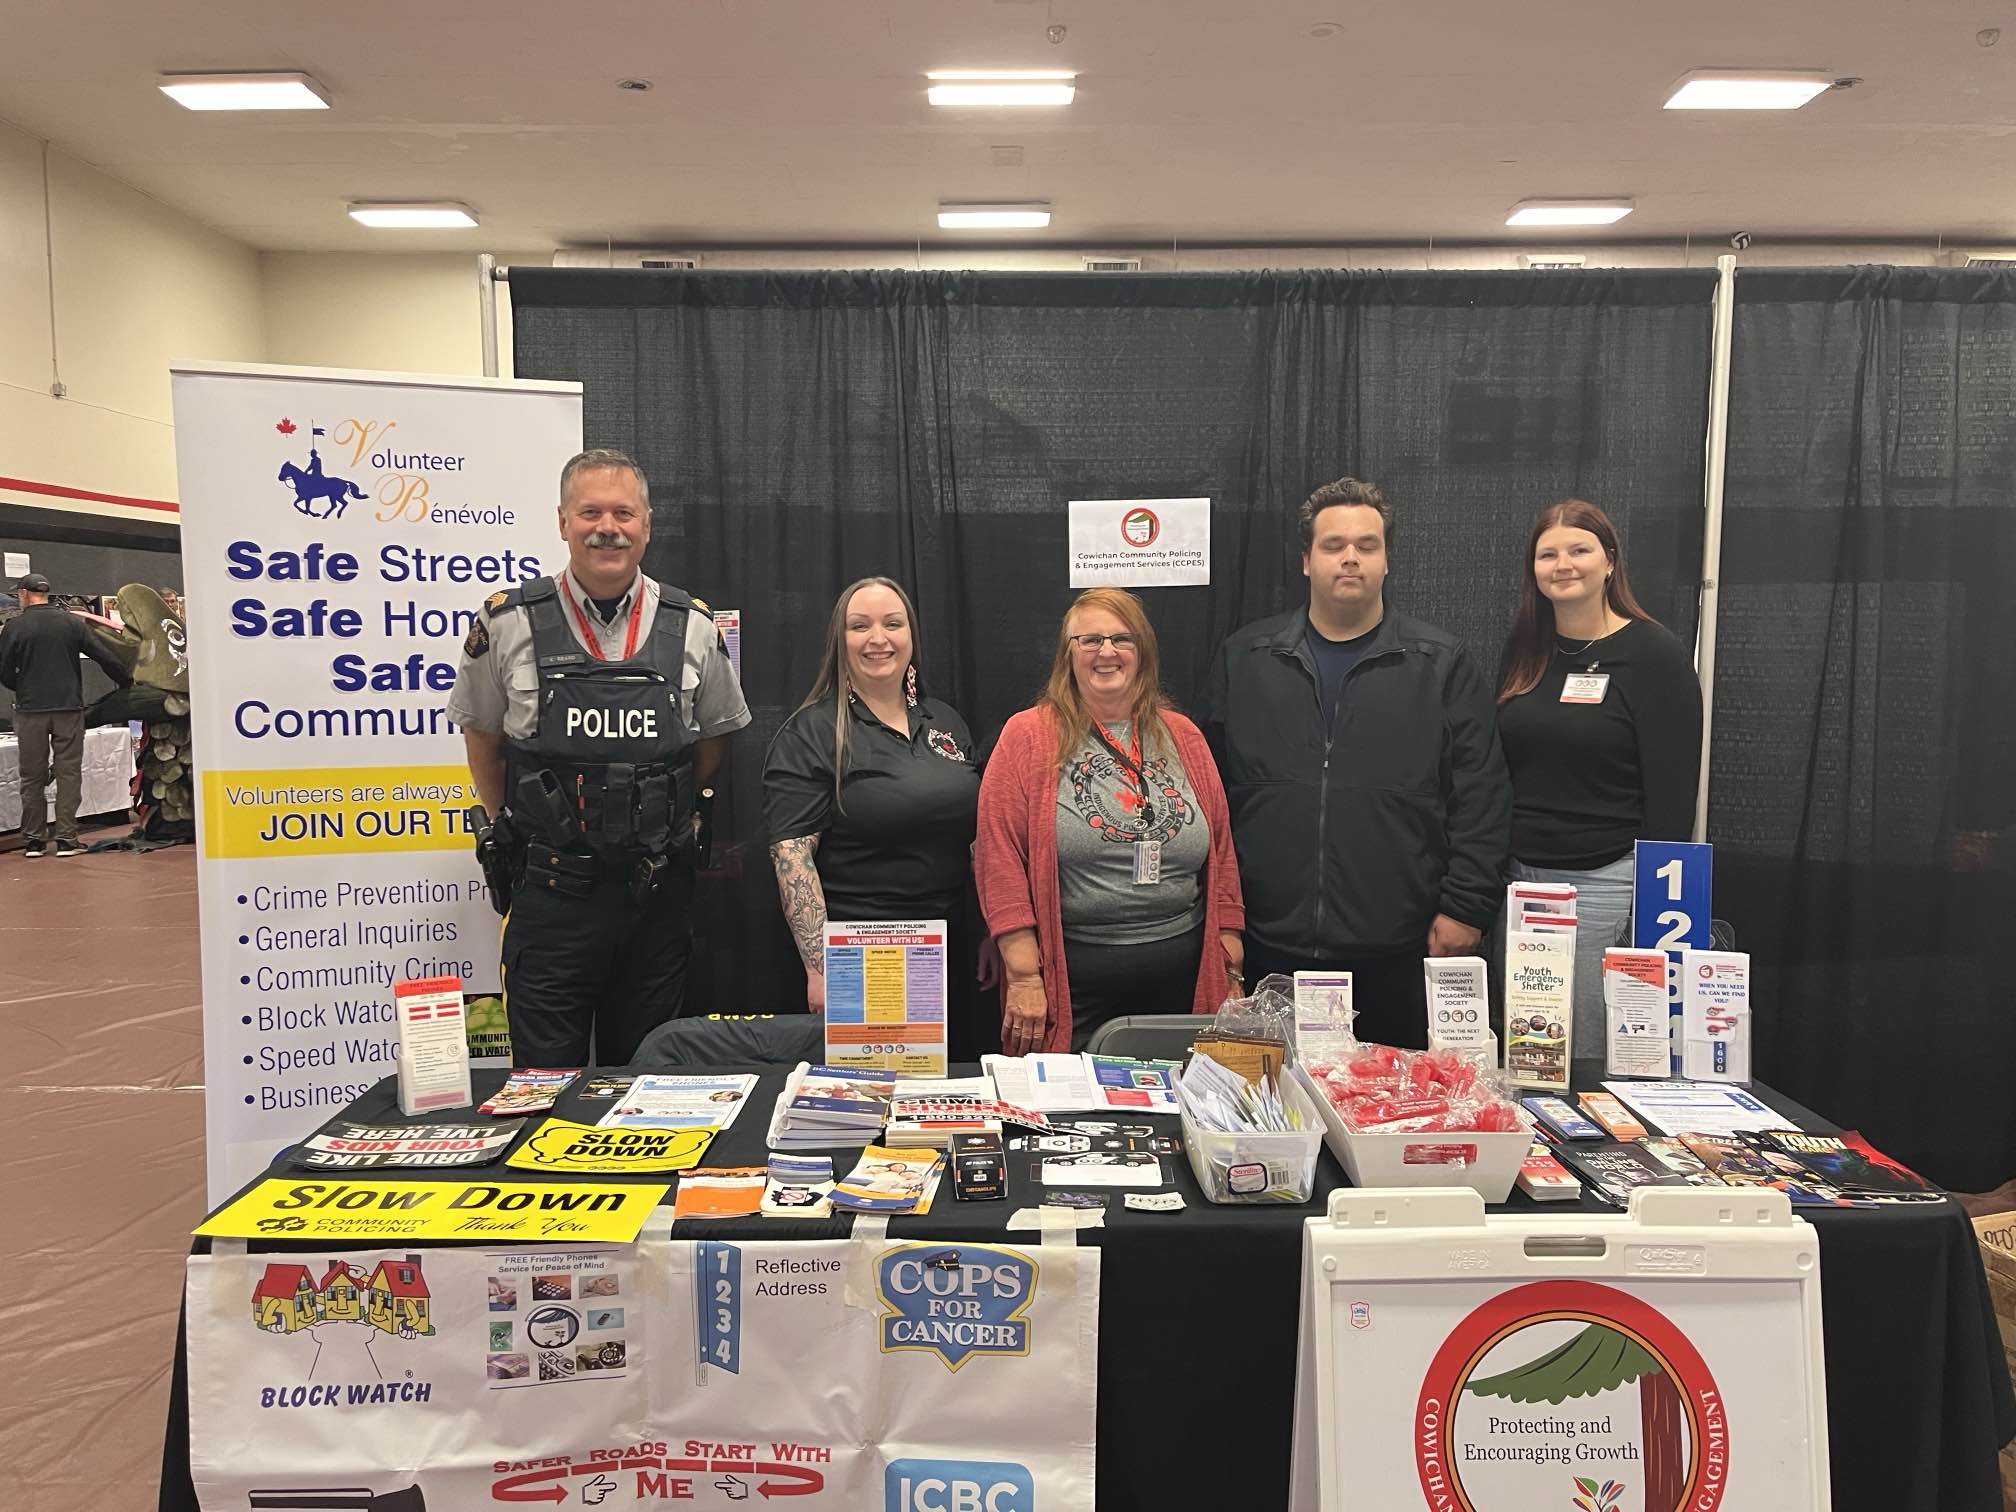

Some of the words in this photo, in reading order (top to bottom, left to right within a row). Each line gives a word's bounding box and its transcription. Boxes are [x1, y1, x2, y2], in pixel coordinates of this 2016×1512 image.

[333, 419, 465, 472] Volunteer
[374, 474, 515, 525] Bénévole
[226, 540, 360, 582] Safe
[379, 544, 541, 583] Streets
[1078, 552, 1118, 560] Cowichan
[1119, 551, 1167, 559] Community
[1169, 550, 1202, 558] Policing
[1083, 561, 1135, 570] Engagement
[1172, 559, 1205, 568] (CCPES)
[231, 598, 363, 639] Safe
[383, 600, 481, 638] Hom
[332, 653, 457, 694] Safe
[234, 700, 464, 739] Commun
[566, 707, 658, 738] POLICE
[226, 784, 345, 807] Volunteers
[351, 787, 385, 803] are
[392, 783, 463, 803] always
[260, 812, 344, 842] JOIN
[355, 808, 432, 838] OUR
[440, 808, 473, 835] TE
[254, 886, 328, 912] Crime
[337, 879, 459, 908] Prevention
[255, 921, 348, 952] General
[357, 918, 458, 949] Inquiries
[847, 937, 891, 945] VOLUNTEER
[912, 936, 925, 944] US!
[256, 958, 396, 992] Community
[405, 956, 474, 982] Crime
[1513, 972, 1564, 986] Emergency
[1523, 965, 1552, 976] Youth
[1521, 981, 1555, 991] Shelter
[257, 1002, 327, 1032] Block
[466, 1033, 508, 1044] MMUNIT
[259, 1042, 336, 1075] Speed
[344, 1037, 399, 1065] Watc
[484, 1046, 511, 1057] WATC
[261, 1079, 370, 1111] Business
[345, 1127, 423, 1140] HERE
[429, 1127, 497, 1139] LIVE
[577, 1133, 675, 1146] SLOW
[1701, 1136, 1744, 1148] STREE
[1773, 1132, 1848, 1149] YOUTH
[325, 1139, 402, 1152] KIDS
[407, 1139, 487, 1151] YOUR
[563, 1144, 670, 1157] DOWN
[305, 1151, 382, 1166] LIKE
[383, 1150, 480, 1165] DRIVE
[273, 1185, 442, 1211] Slow
[446, 1185, 627, 1211] Down
[313, 1225, 419, 1234] POLICING
[315, 1218, 431, 1227] COMMUNITY
[453, 1215, 529, 1233] Thank
[538, 1216, 592, 1236] You
[530, 1255, 564, 1263] Friendly
[584, 1261, 605, 1269] Mind
[755, 1257, 841, 1275] Reflective
[755, 1280, 828, 1297] Address
[889, 1258, 1022, 1300] COPS
[927, 1300, 983, 1320] FOR
[890, 1320, 1018, 1348] CANCER
[260, 1383, 340, 1409] BLOCK
[347, 1382, 432, 1405] WATCH
[1488, 1416, 1576, 1437] Protecting
[1580, 1416, 1612, 1434] and
[493, 1454, 572, 1473] SAFER
[589, 1441, 668, 1461] ROADS
[685, 1439, 756, 1460] START
[771, 1442, 831, 1463] WITH
[1464, 1443, 1571, 1465] Encouraging
[1575, 1442, 1639, 1461] Growth
[1695, 1389, 1724, 1512] GAGEMENT
[635, 1472, 694, 1500] ME
[900, 1477, 1021, 1512] ICBC
